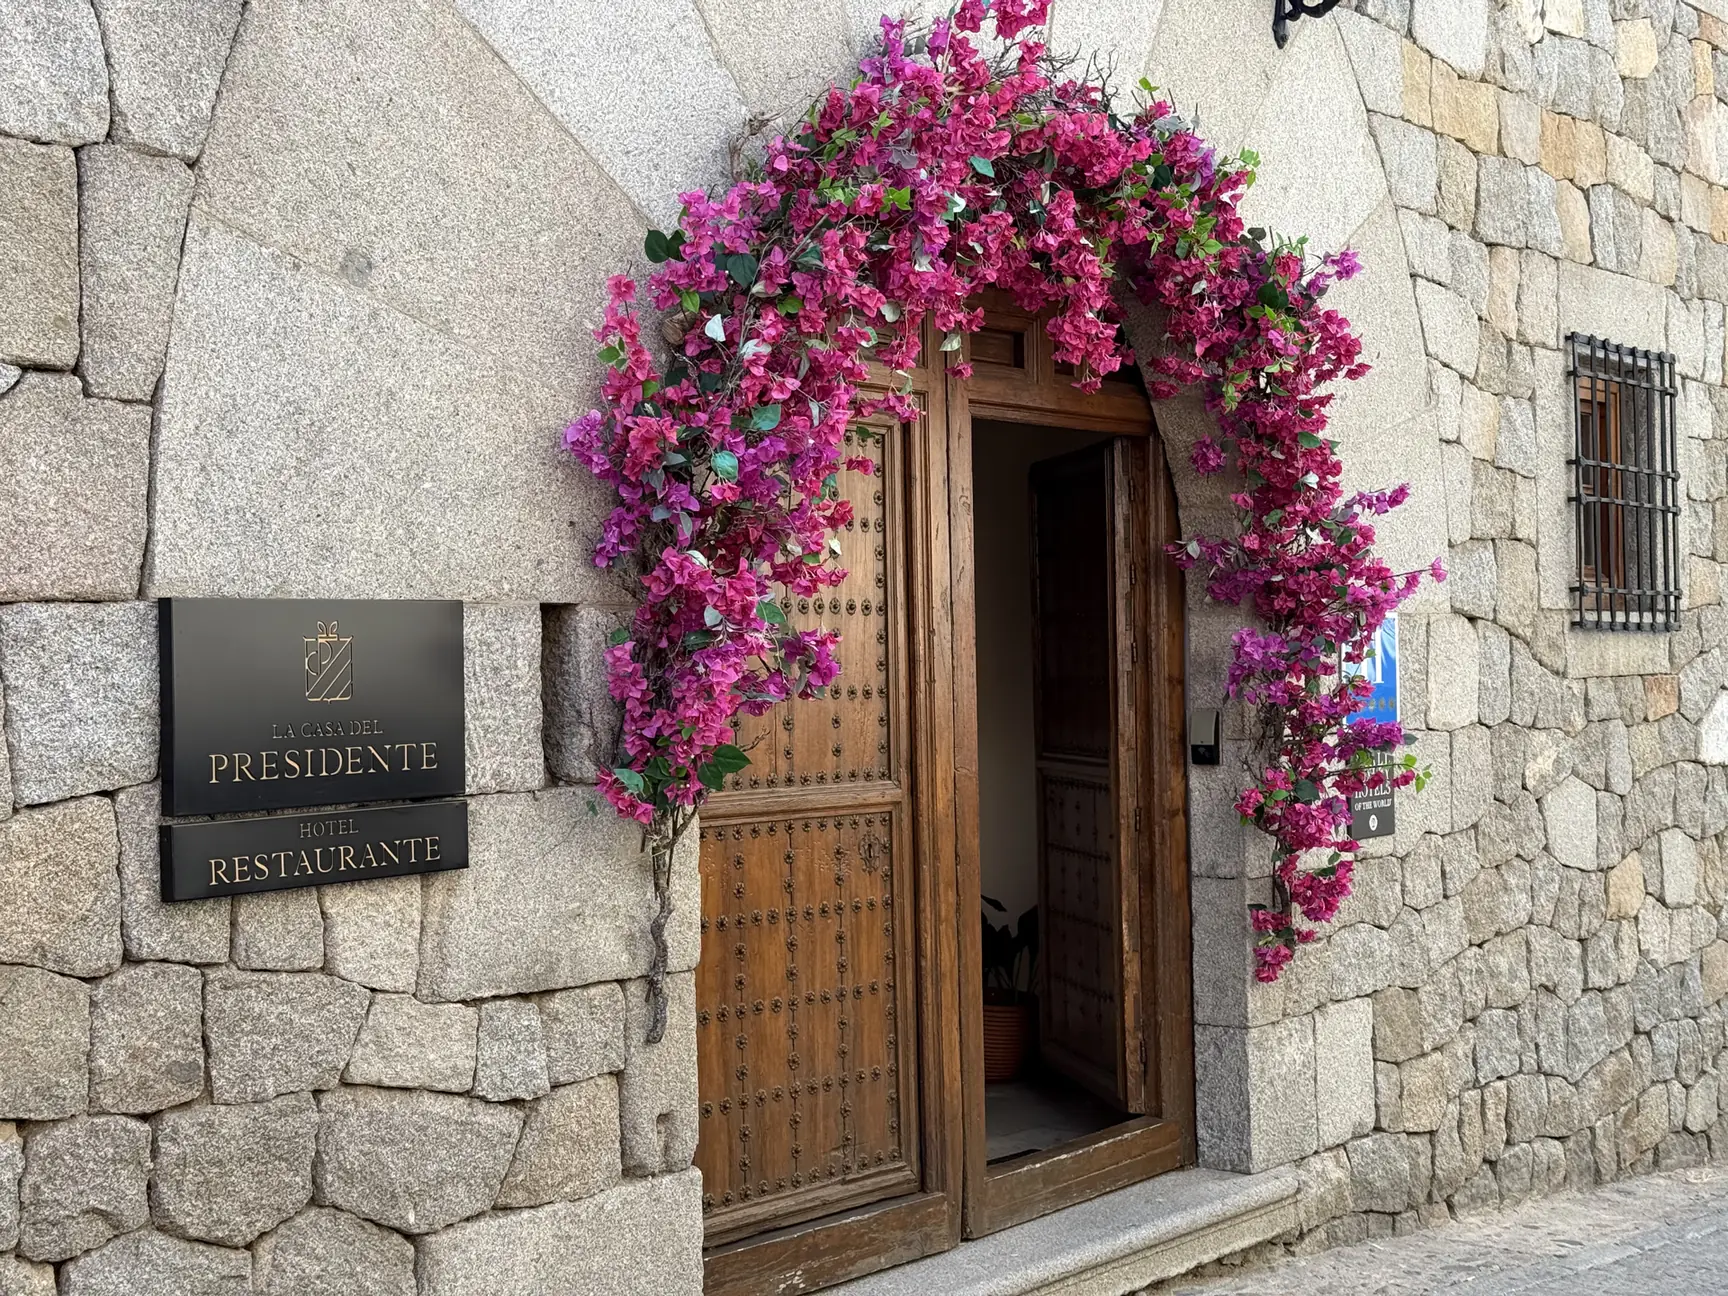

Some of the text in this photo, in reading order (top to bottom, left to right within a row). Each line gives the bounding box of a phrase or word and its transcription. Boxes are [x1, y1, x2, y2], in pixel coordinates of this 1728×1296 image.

[272, 719, 384, 739] LA CASA DEL
[208, 742, 438, 784] PRESIDENTE
[1354, 802, 1362, 811] OF
[1362, 801, 1373, 810] THE
[299, 818, 359, 838] HOTEL
[208, 836, 441, 886] RESTAURANTE
